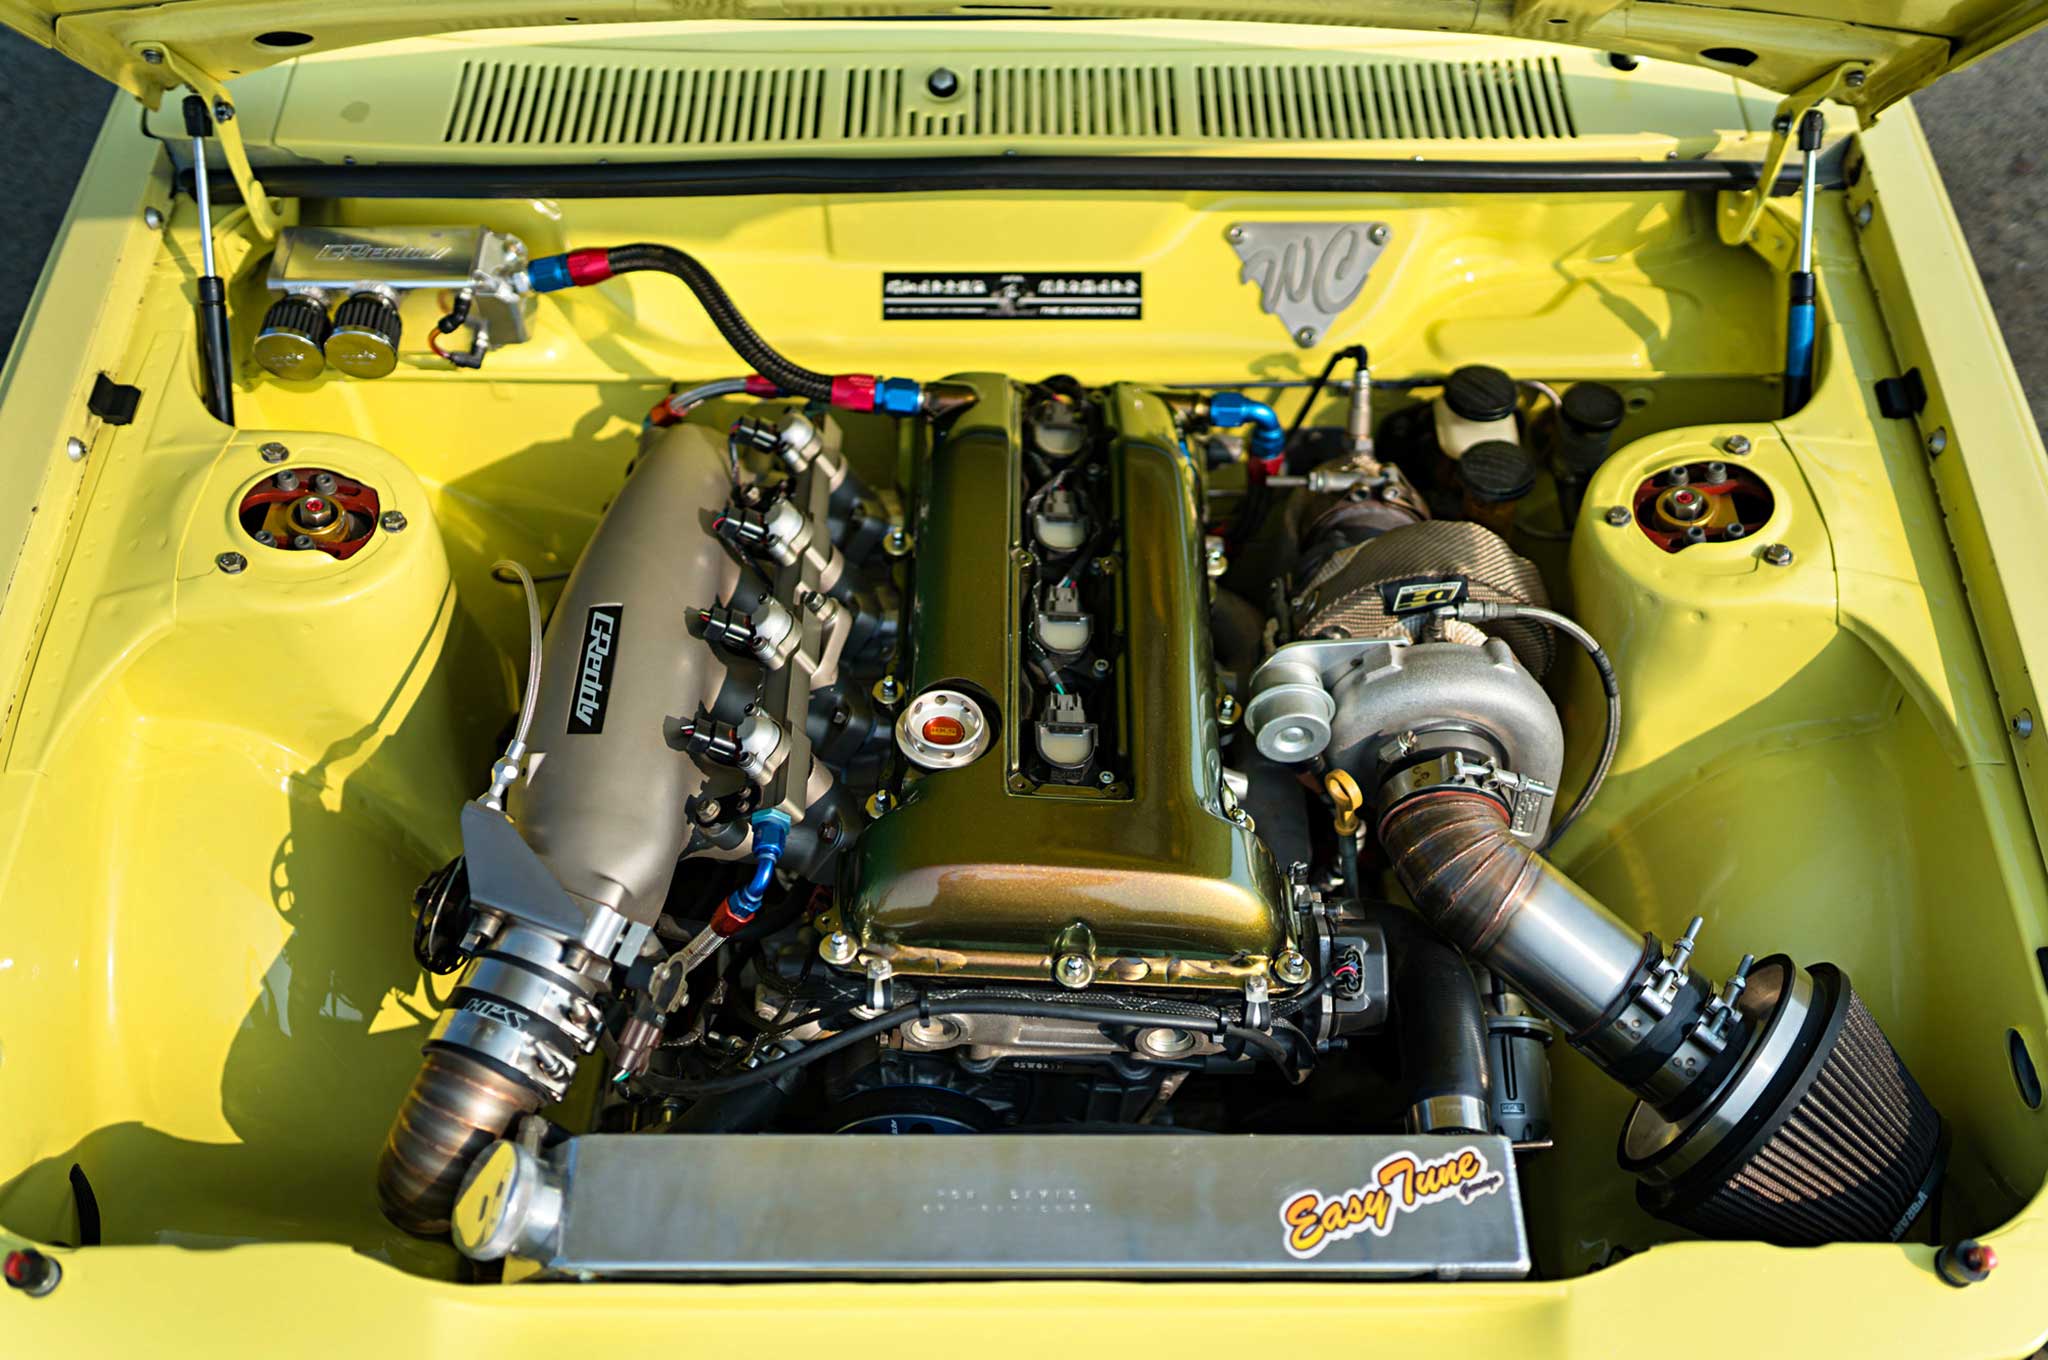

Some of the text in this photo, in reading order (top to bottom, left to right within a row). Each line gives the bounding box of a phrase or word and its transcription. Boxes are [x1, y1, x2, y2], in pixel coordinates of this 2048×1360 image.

[575, 611, 615, 727] GReddy
[464, 998, 529, 1031] HPS
[1285, 1188, 1391, 1251] Easy
[1378, 1151, 1481, 1206] Tune
